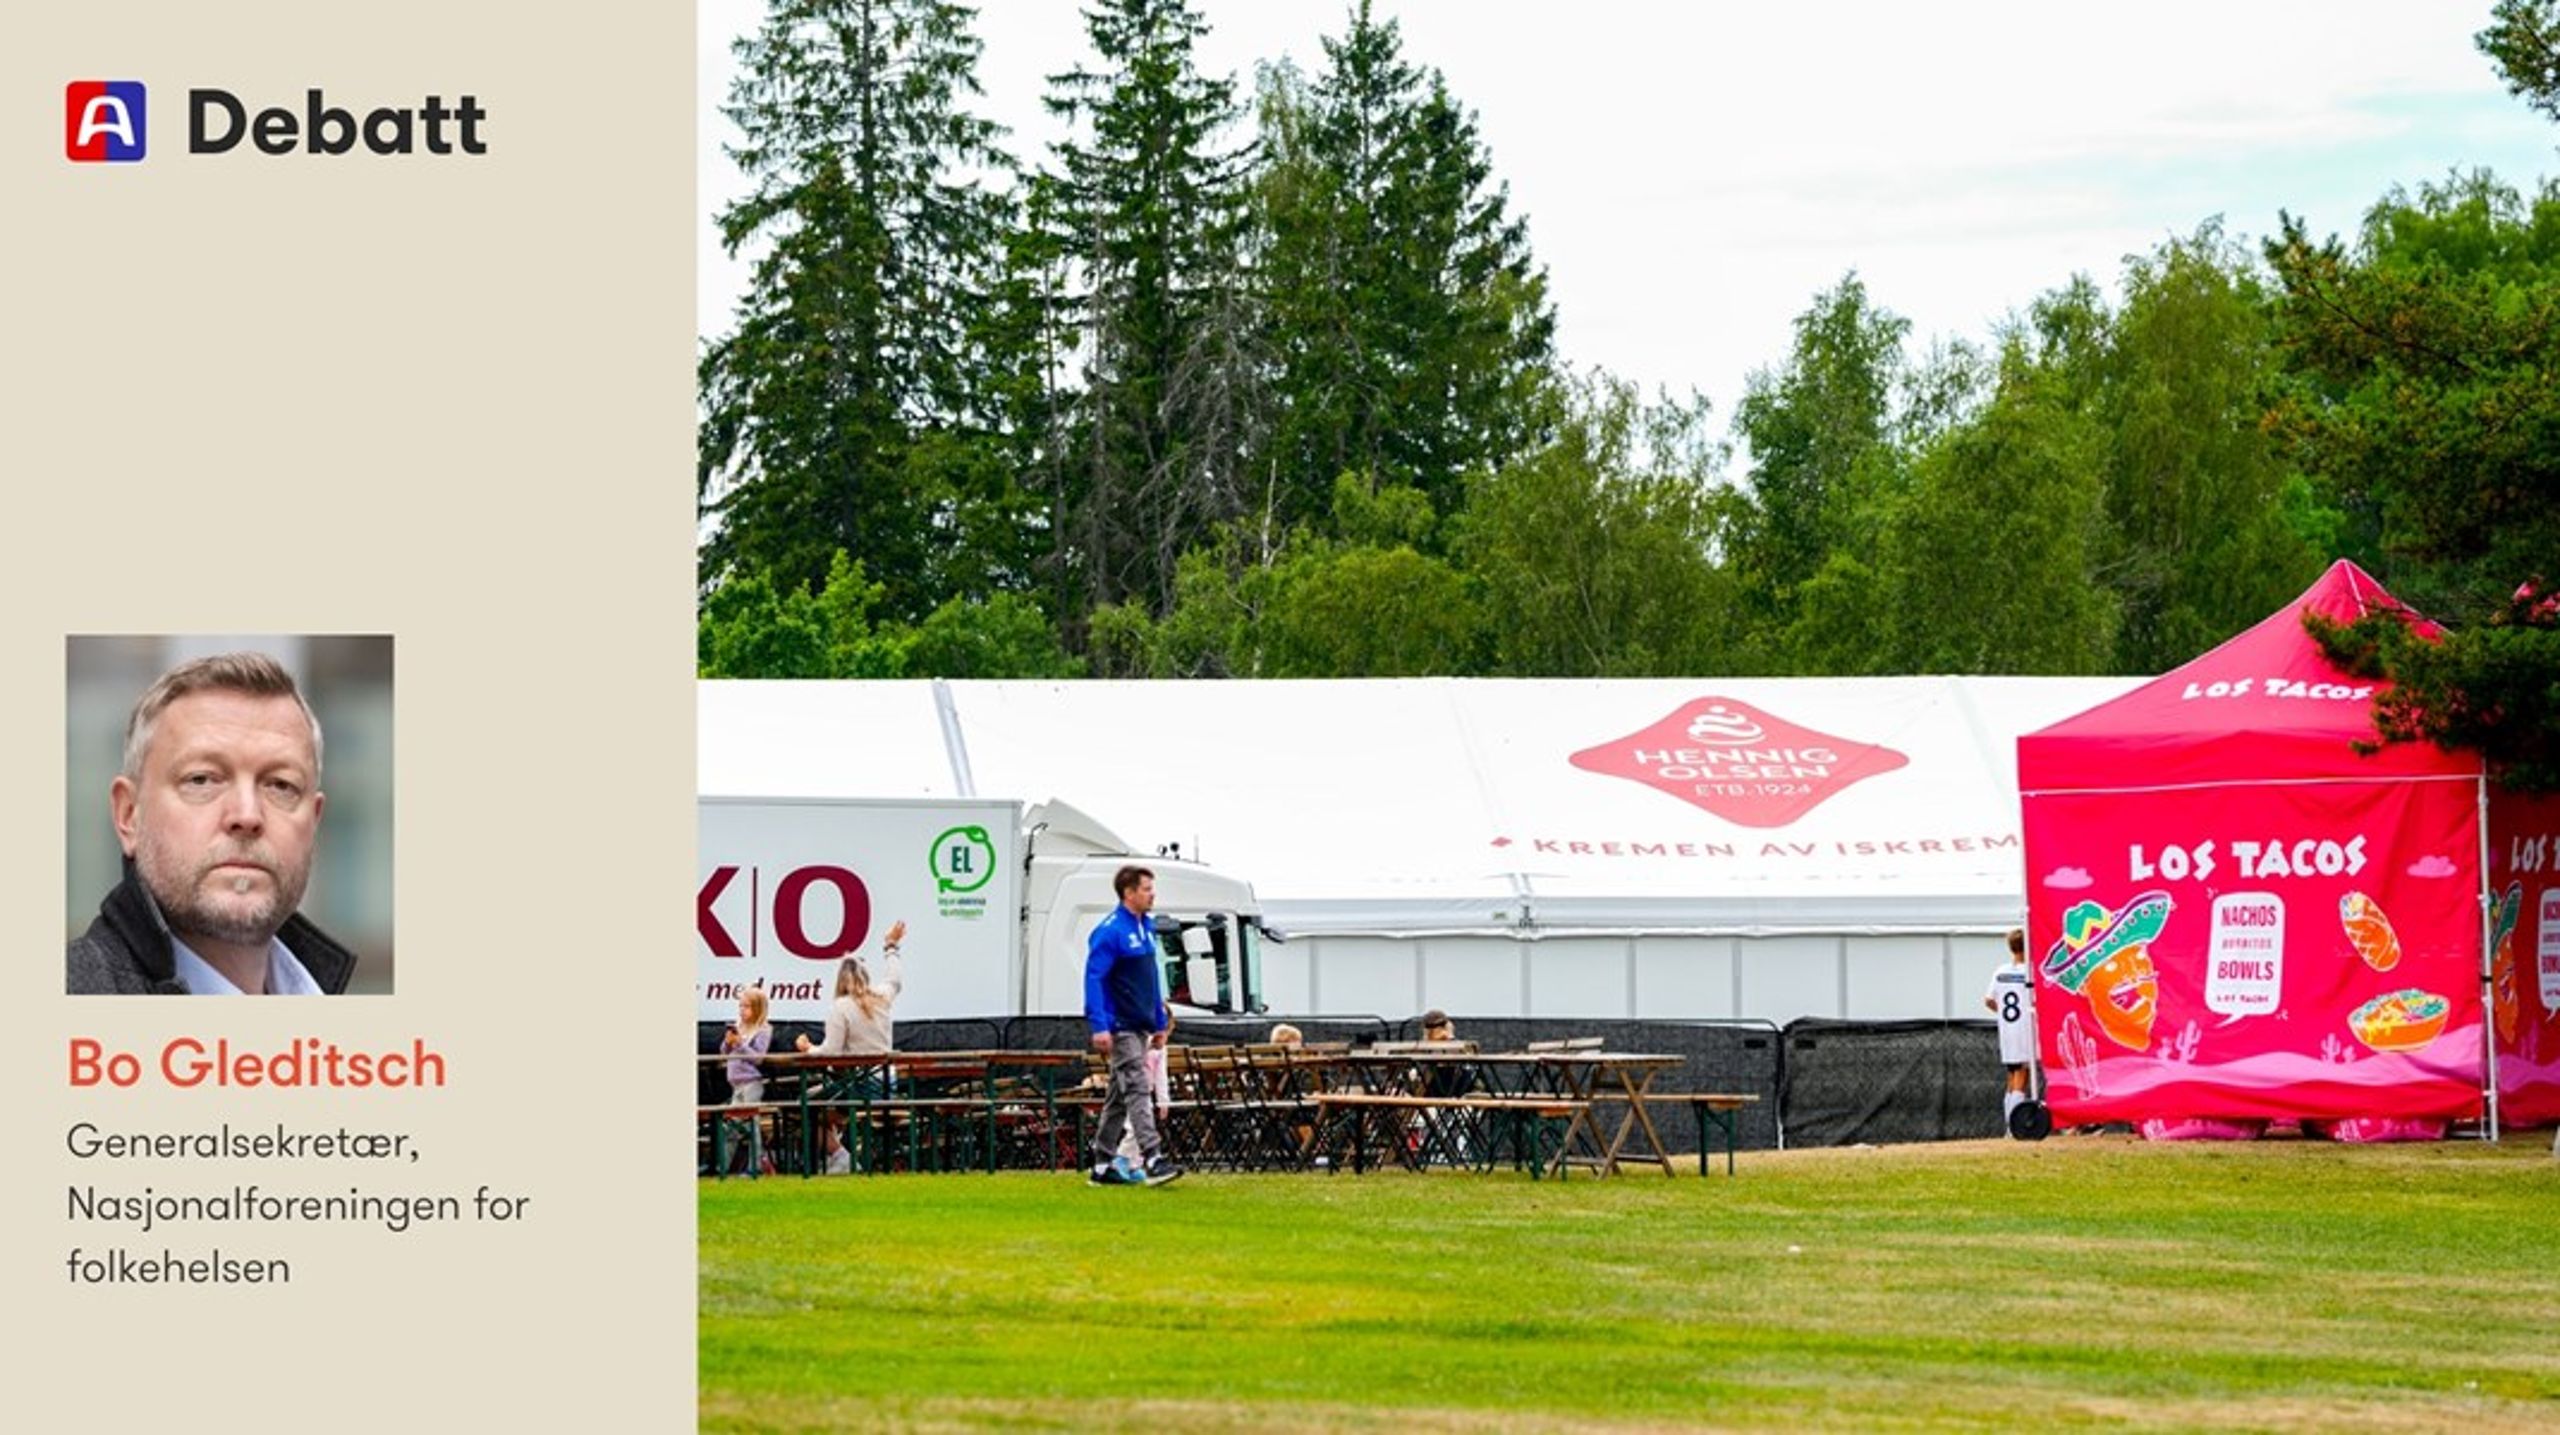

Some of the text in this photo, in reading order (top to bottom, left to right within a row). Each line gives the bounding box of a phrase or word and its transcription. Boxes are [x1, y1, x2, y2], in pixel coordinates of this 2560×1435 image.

[2182, 678, 2373, 700] LOS TACOS
[1634, 747, 1838, 765] HENNIG
[1658, 764, 1830, 780] OLSEN
[1534, 834, 2019, 857] KREMEN AV ISKREM
[2510, 833, 2548, 873] LOS
[951, 846, 974, 873] EL
[2129, 834, 2368, 881] LOS TACOS
[2221, 905, 2276, 927] NACHOS
[2217, 960, 2274, 980] BOWLS
[770, 978, 823, 1000] mat
[2002, 991, 2022, 1023] 8
